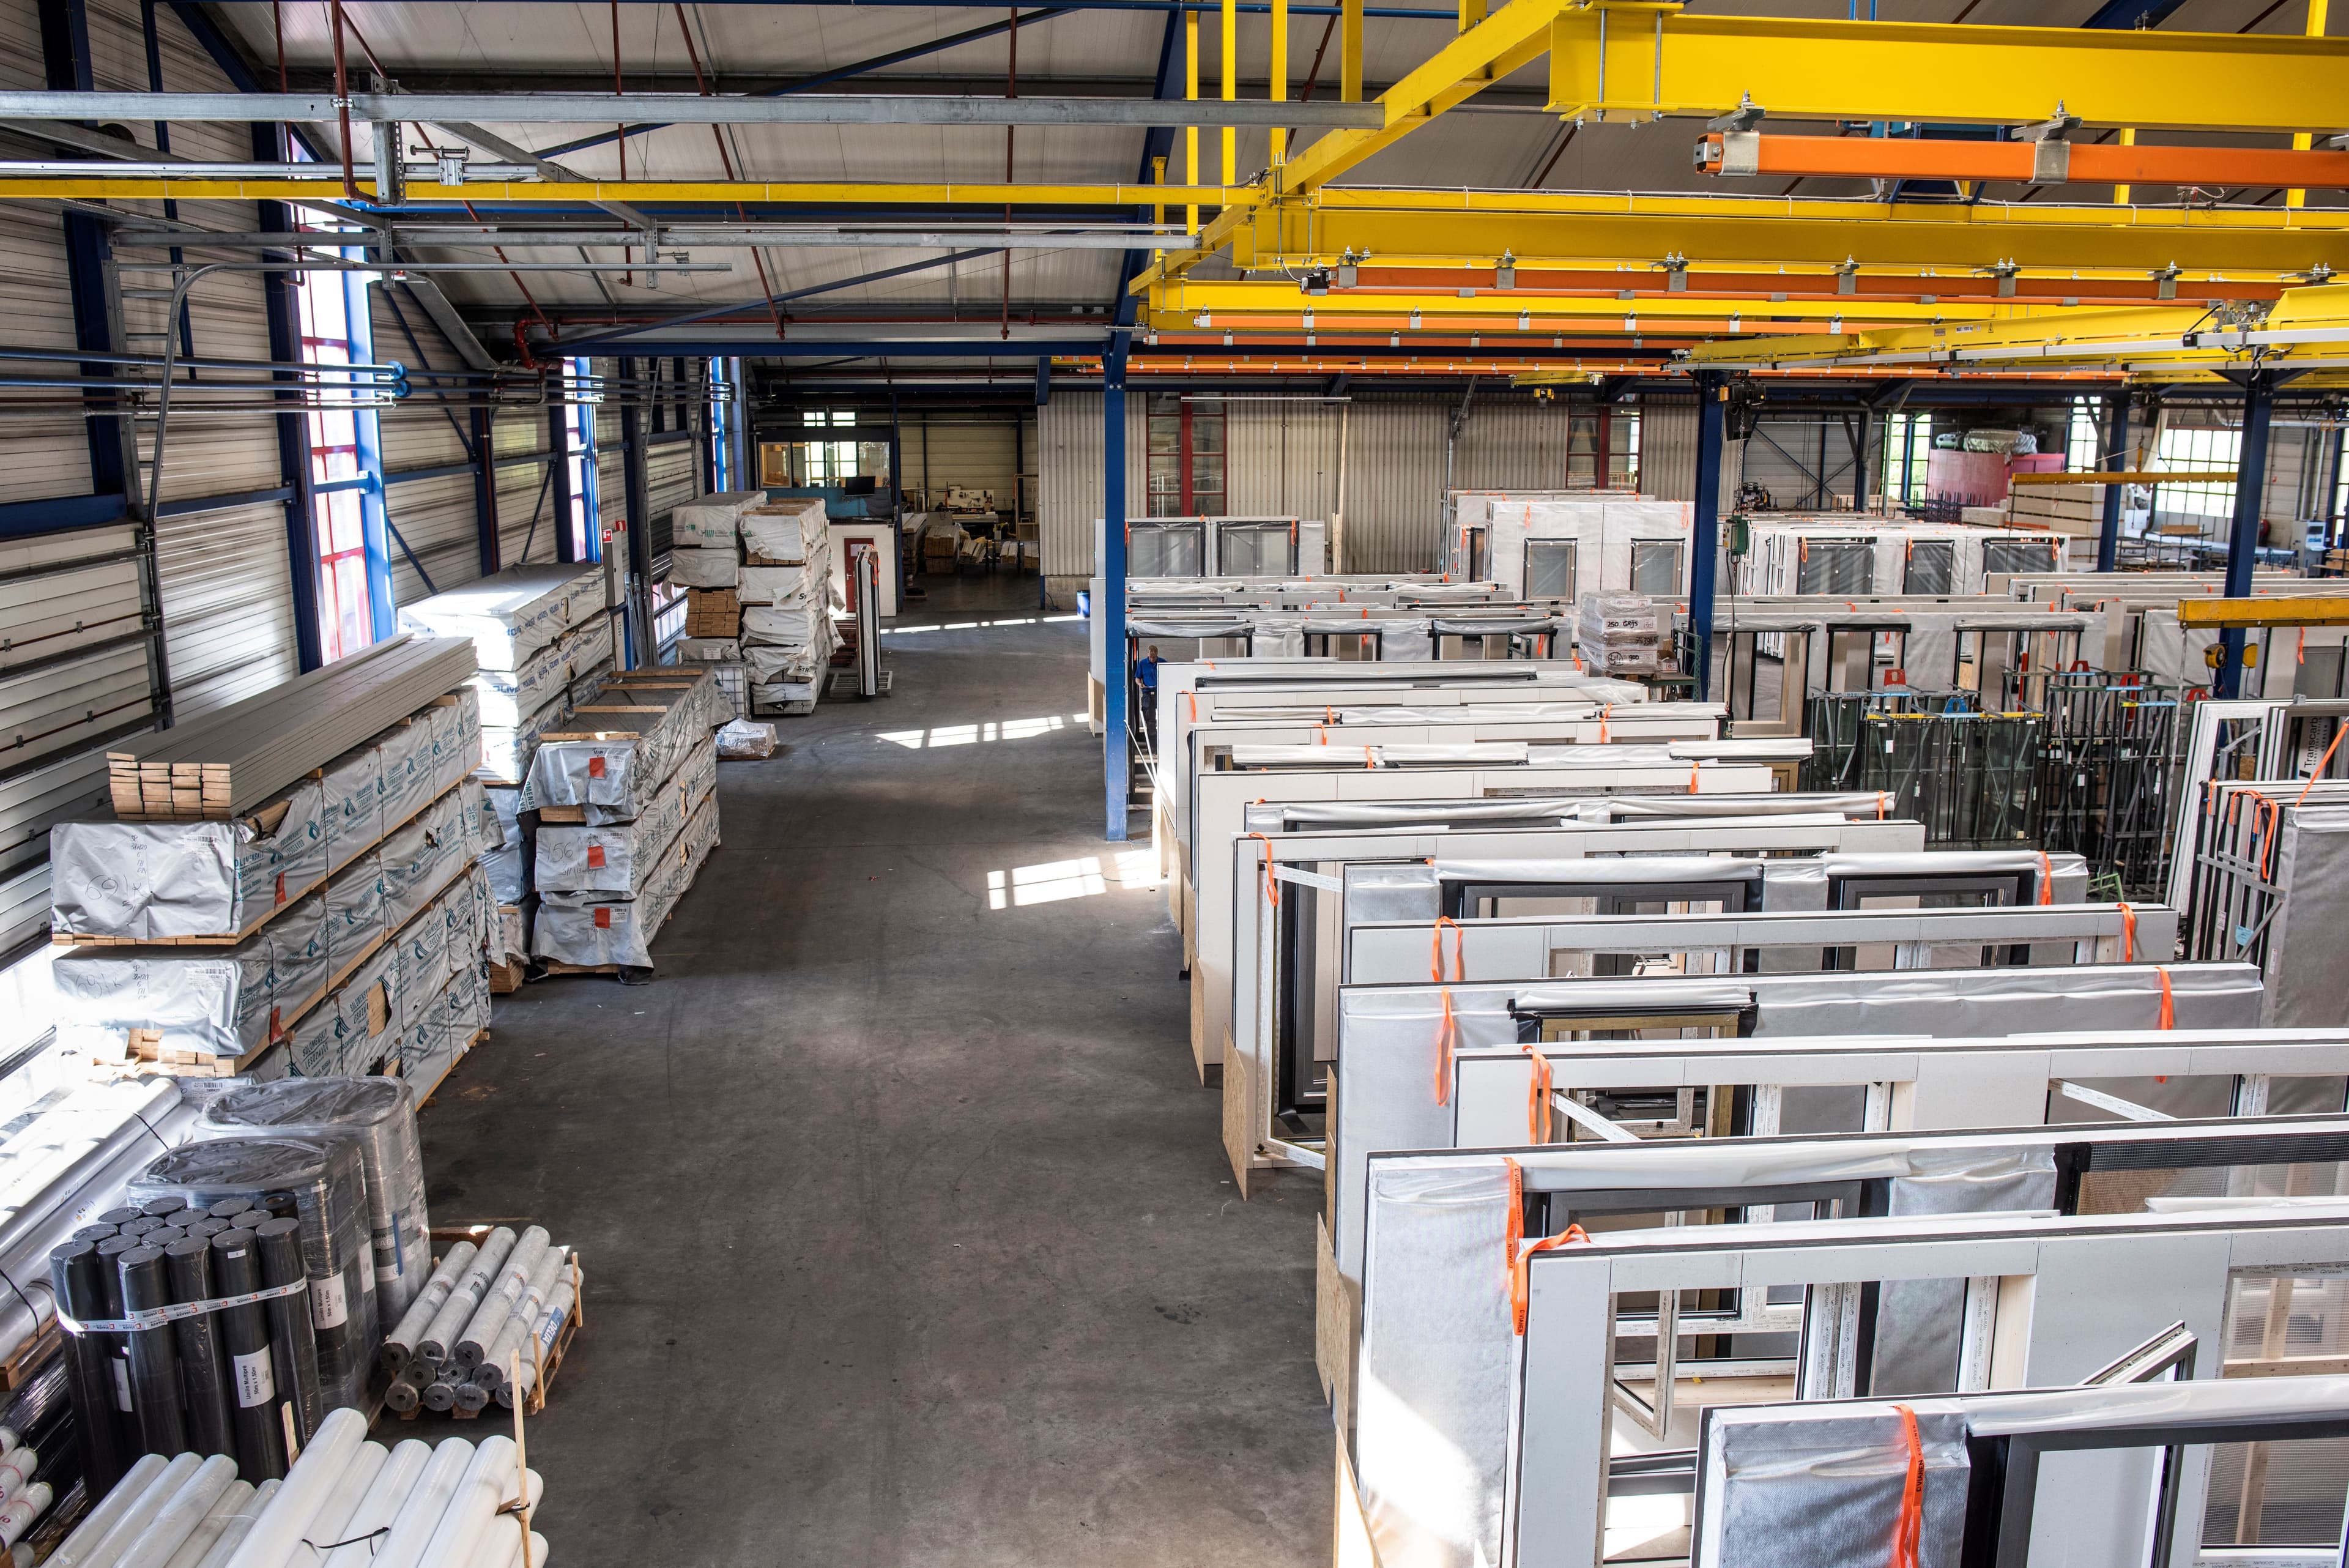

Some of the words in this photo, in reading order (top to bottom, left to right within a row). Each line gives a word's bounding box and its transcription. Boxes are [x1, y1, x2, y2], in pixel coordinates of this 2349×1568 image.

[547, 842, 573, 862] 156
[238, 863, 262, 879] ESOZAVOD
[302, 1028, 328, 1056] SOLOMENSKIY
[306, 1042, 328, 1069] LESOZAVOD
[543, 1321, 558, 1347] DELTA
